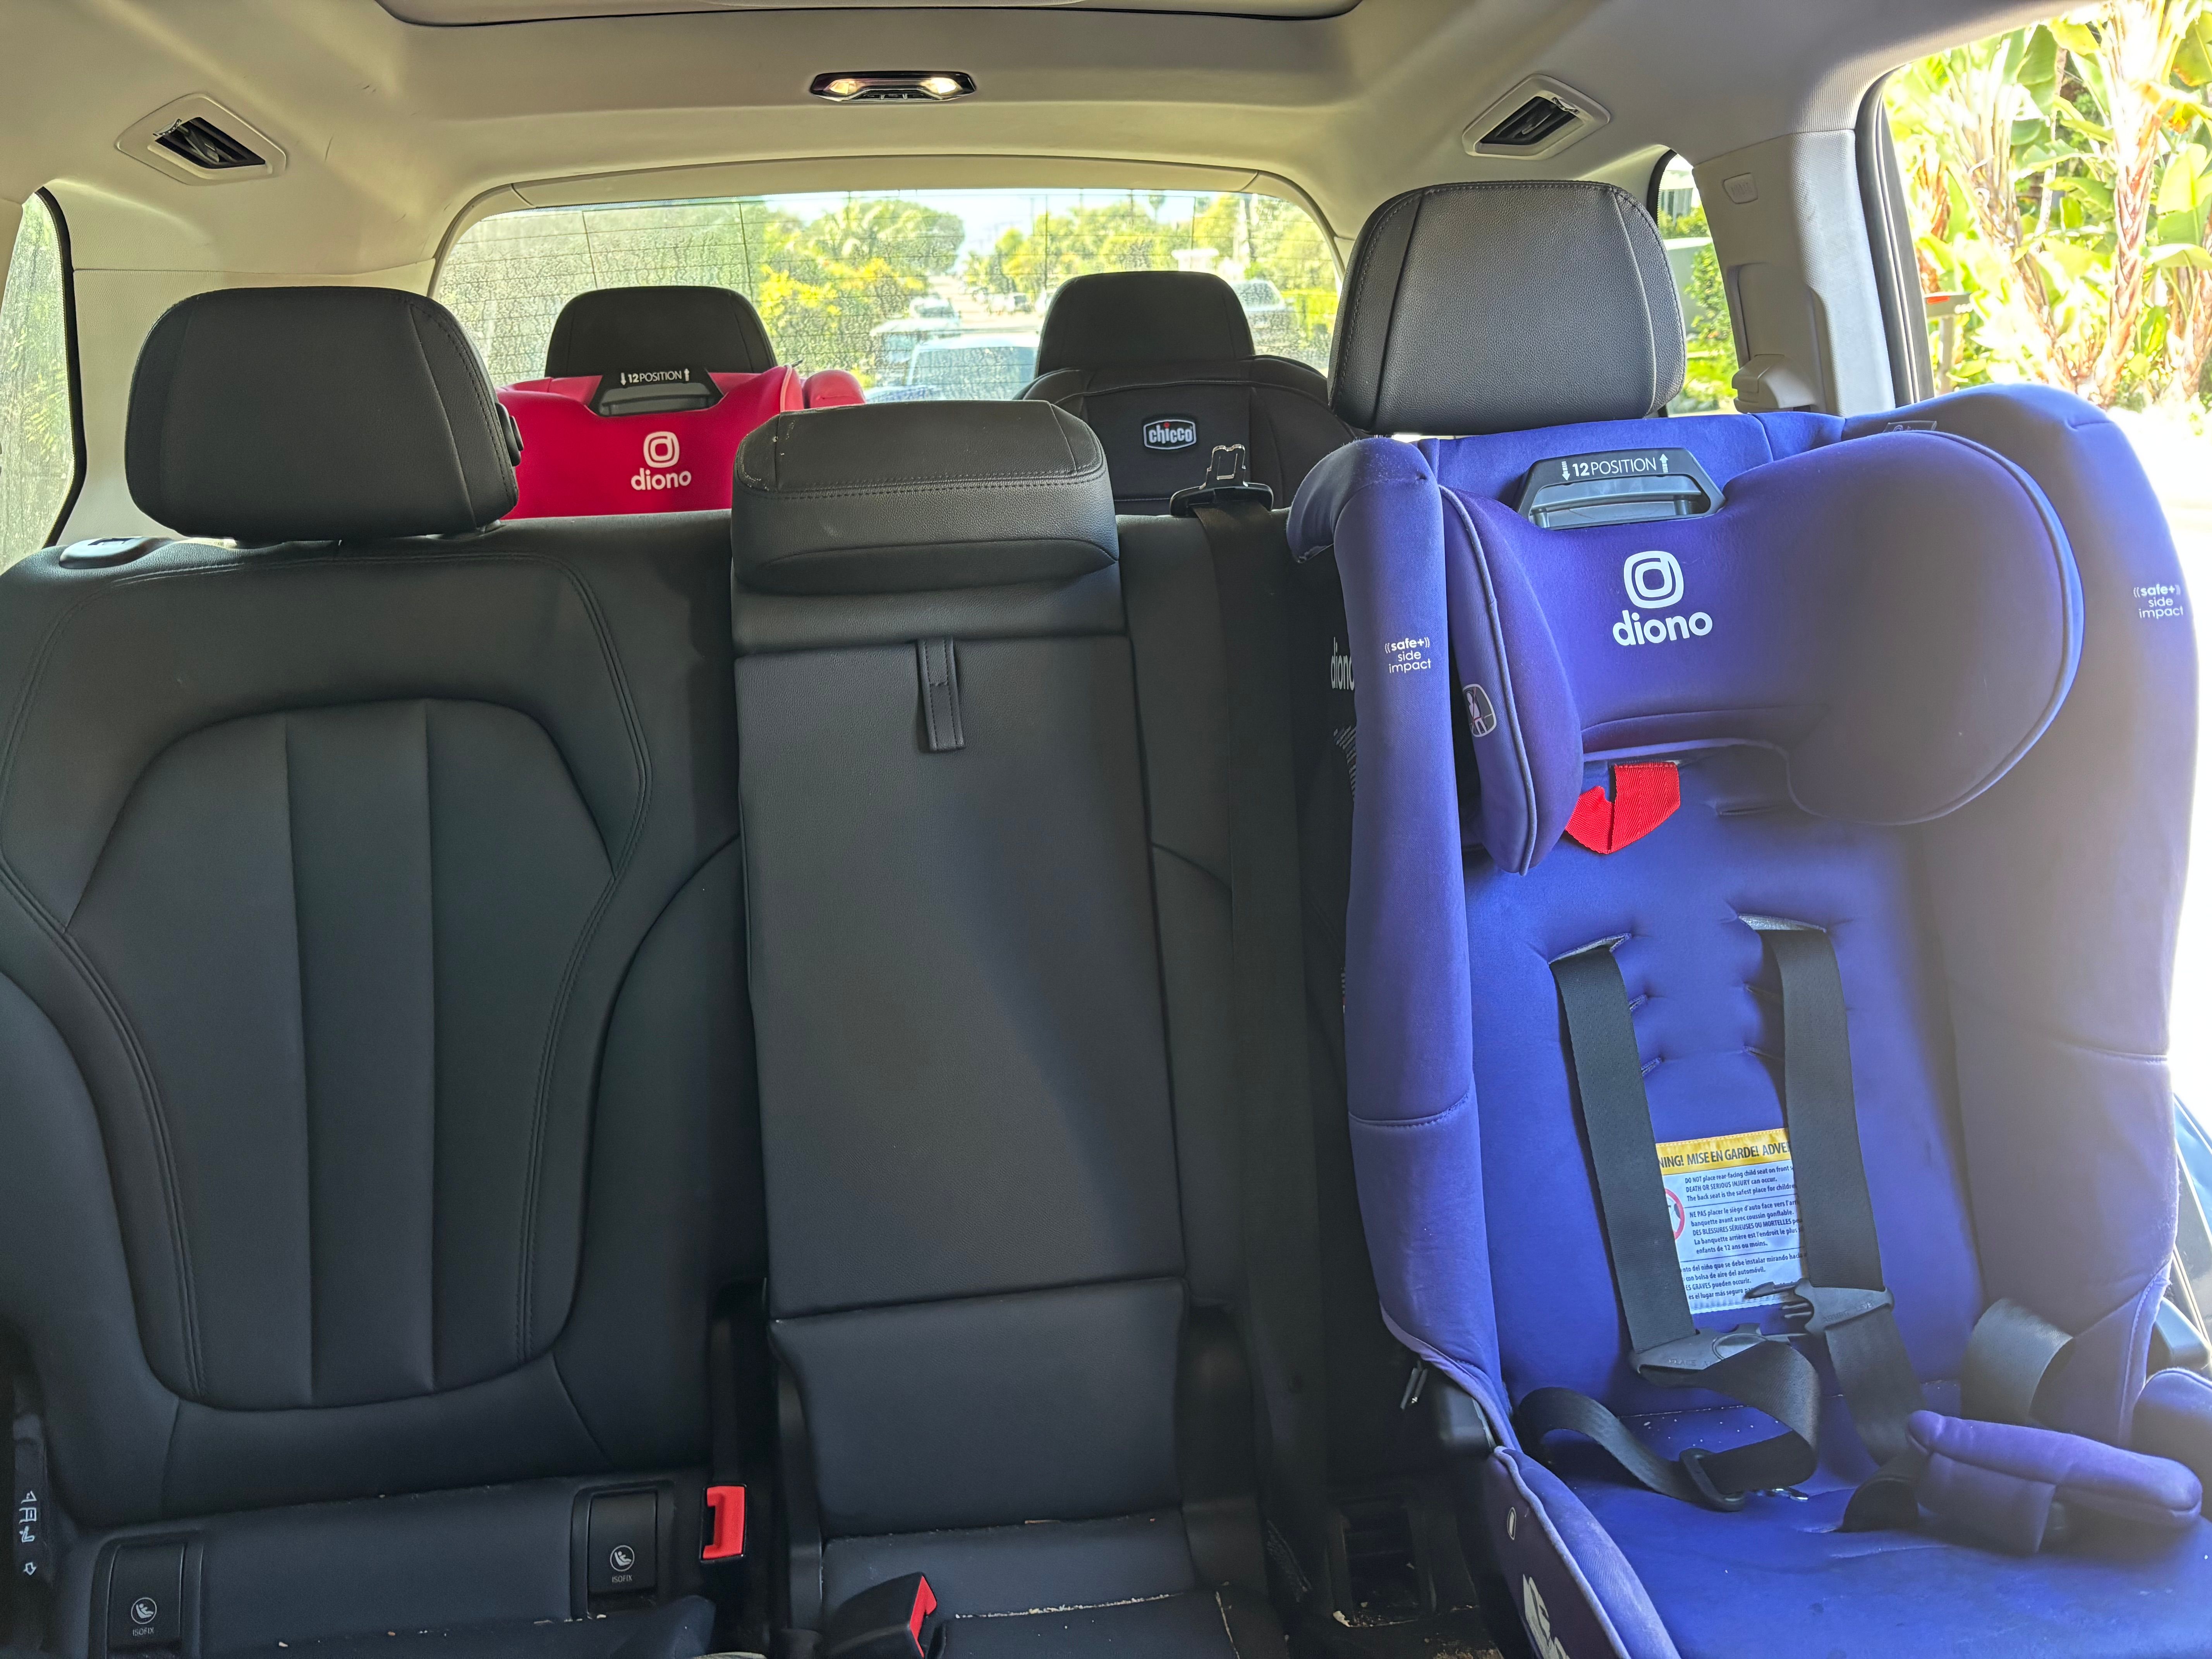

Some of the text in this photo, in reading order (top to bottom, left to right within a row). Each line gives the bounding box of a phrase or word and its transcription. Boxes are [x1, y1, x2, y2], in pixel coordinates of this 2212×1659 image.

[1149, 422, 1193, 444] chicco
[630, 468, 692, 491] diono
[2148, 597, 2173, 607] side
[2138, 606, 2184, 619] impact
[1613, 610, 1713, 646] diono
[1398, 651, 1422, 662] side
[1389, 658, 1431, 673] impact
[1687, 1152, 1710, 1165] MISE
[1711, 1150, 1723, 1162] EN
[1725, 1146, 1759, 1160] GARDE!
[1716, 1171, 1743, 1180] rear-facing
[1711, 1182, 1731, 1190] SERIOUS
[1702, 1226, 1729, 1235] BLESSURES
[1763, 1218, 1792, 1227] MORTELLES
[1701, 1236, 1728, 1244] banquette
[1786, 1227, 1797, 1235] plus
[1692, 1282, 1711, 1290] GRAVES
[1712, 1280, 1731, 1289] pueden
[612, 1575, 632, 1583] ISOFIX
[132, 1627, 154, 1636] ISOFIX
